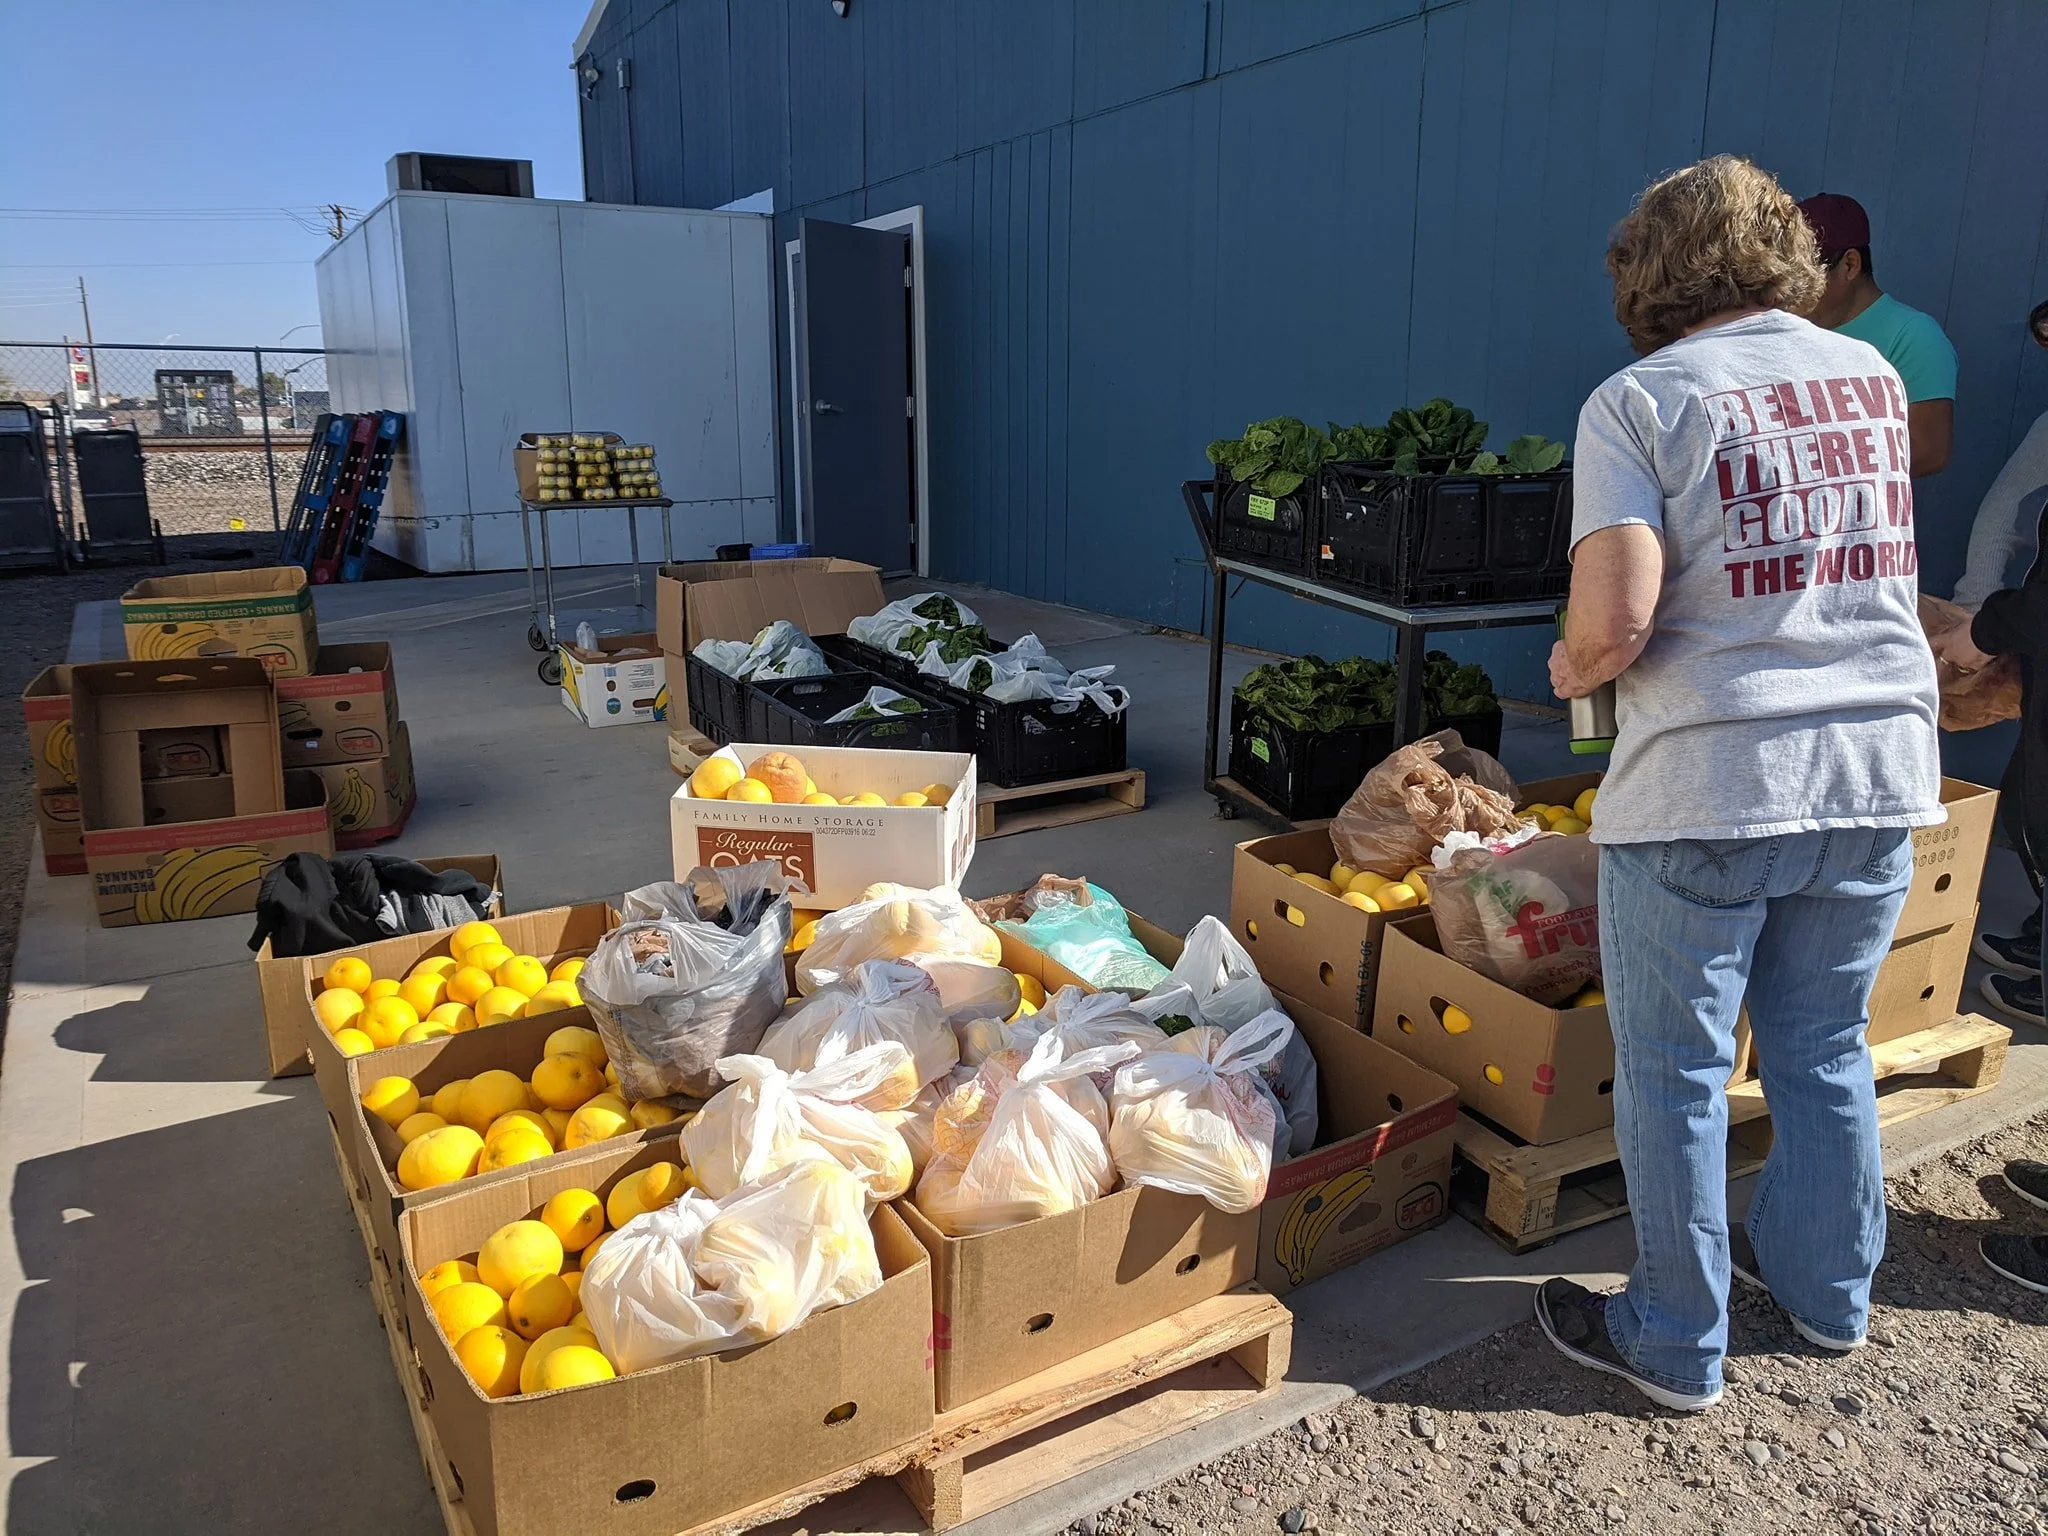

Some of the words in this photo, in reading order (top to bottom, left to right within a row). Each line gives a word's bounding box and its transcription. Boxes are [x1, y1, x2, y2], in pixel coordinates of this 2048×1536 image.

[1704, 376, 1905, 443] BELIEVE
[1716, 428, 1879, 499] THERE
[1884, 426, 1909, 475] IS
[1724, 481, 1877, 551] GOOD
[1724, 553, 1806, 598] THE
[1814, 541, 1918, 586] WORLD
[208, 607, 249, 618] CERTIFIED
[261, 654, 288, 668] Dol
[694, 810, 749, 822] FAMILY
[759, 814, 803, 825] HOME
[814, 816, 884, 827] STORAGE
[715, 831, 794, 856] Regular
[96, 868, 154, 884] BANANAS
[99, 881, 156, 896] PREMIUM
[1536, 913, 1572, 928] FOOD
[1574, 905, 1598, 918] STO
[1548, 960, 1585, 977] Fresh
[1284, 1165, 1326, 1187] BANANAS
